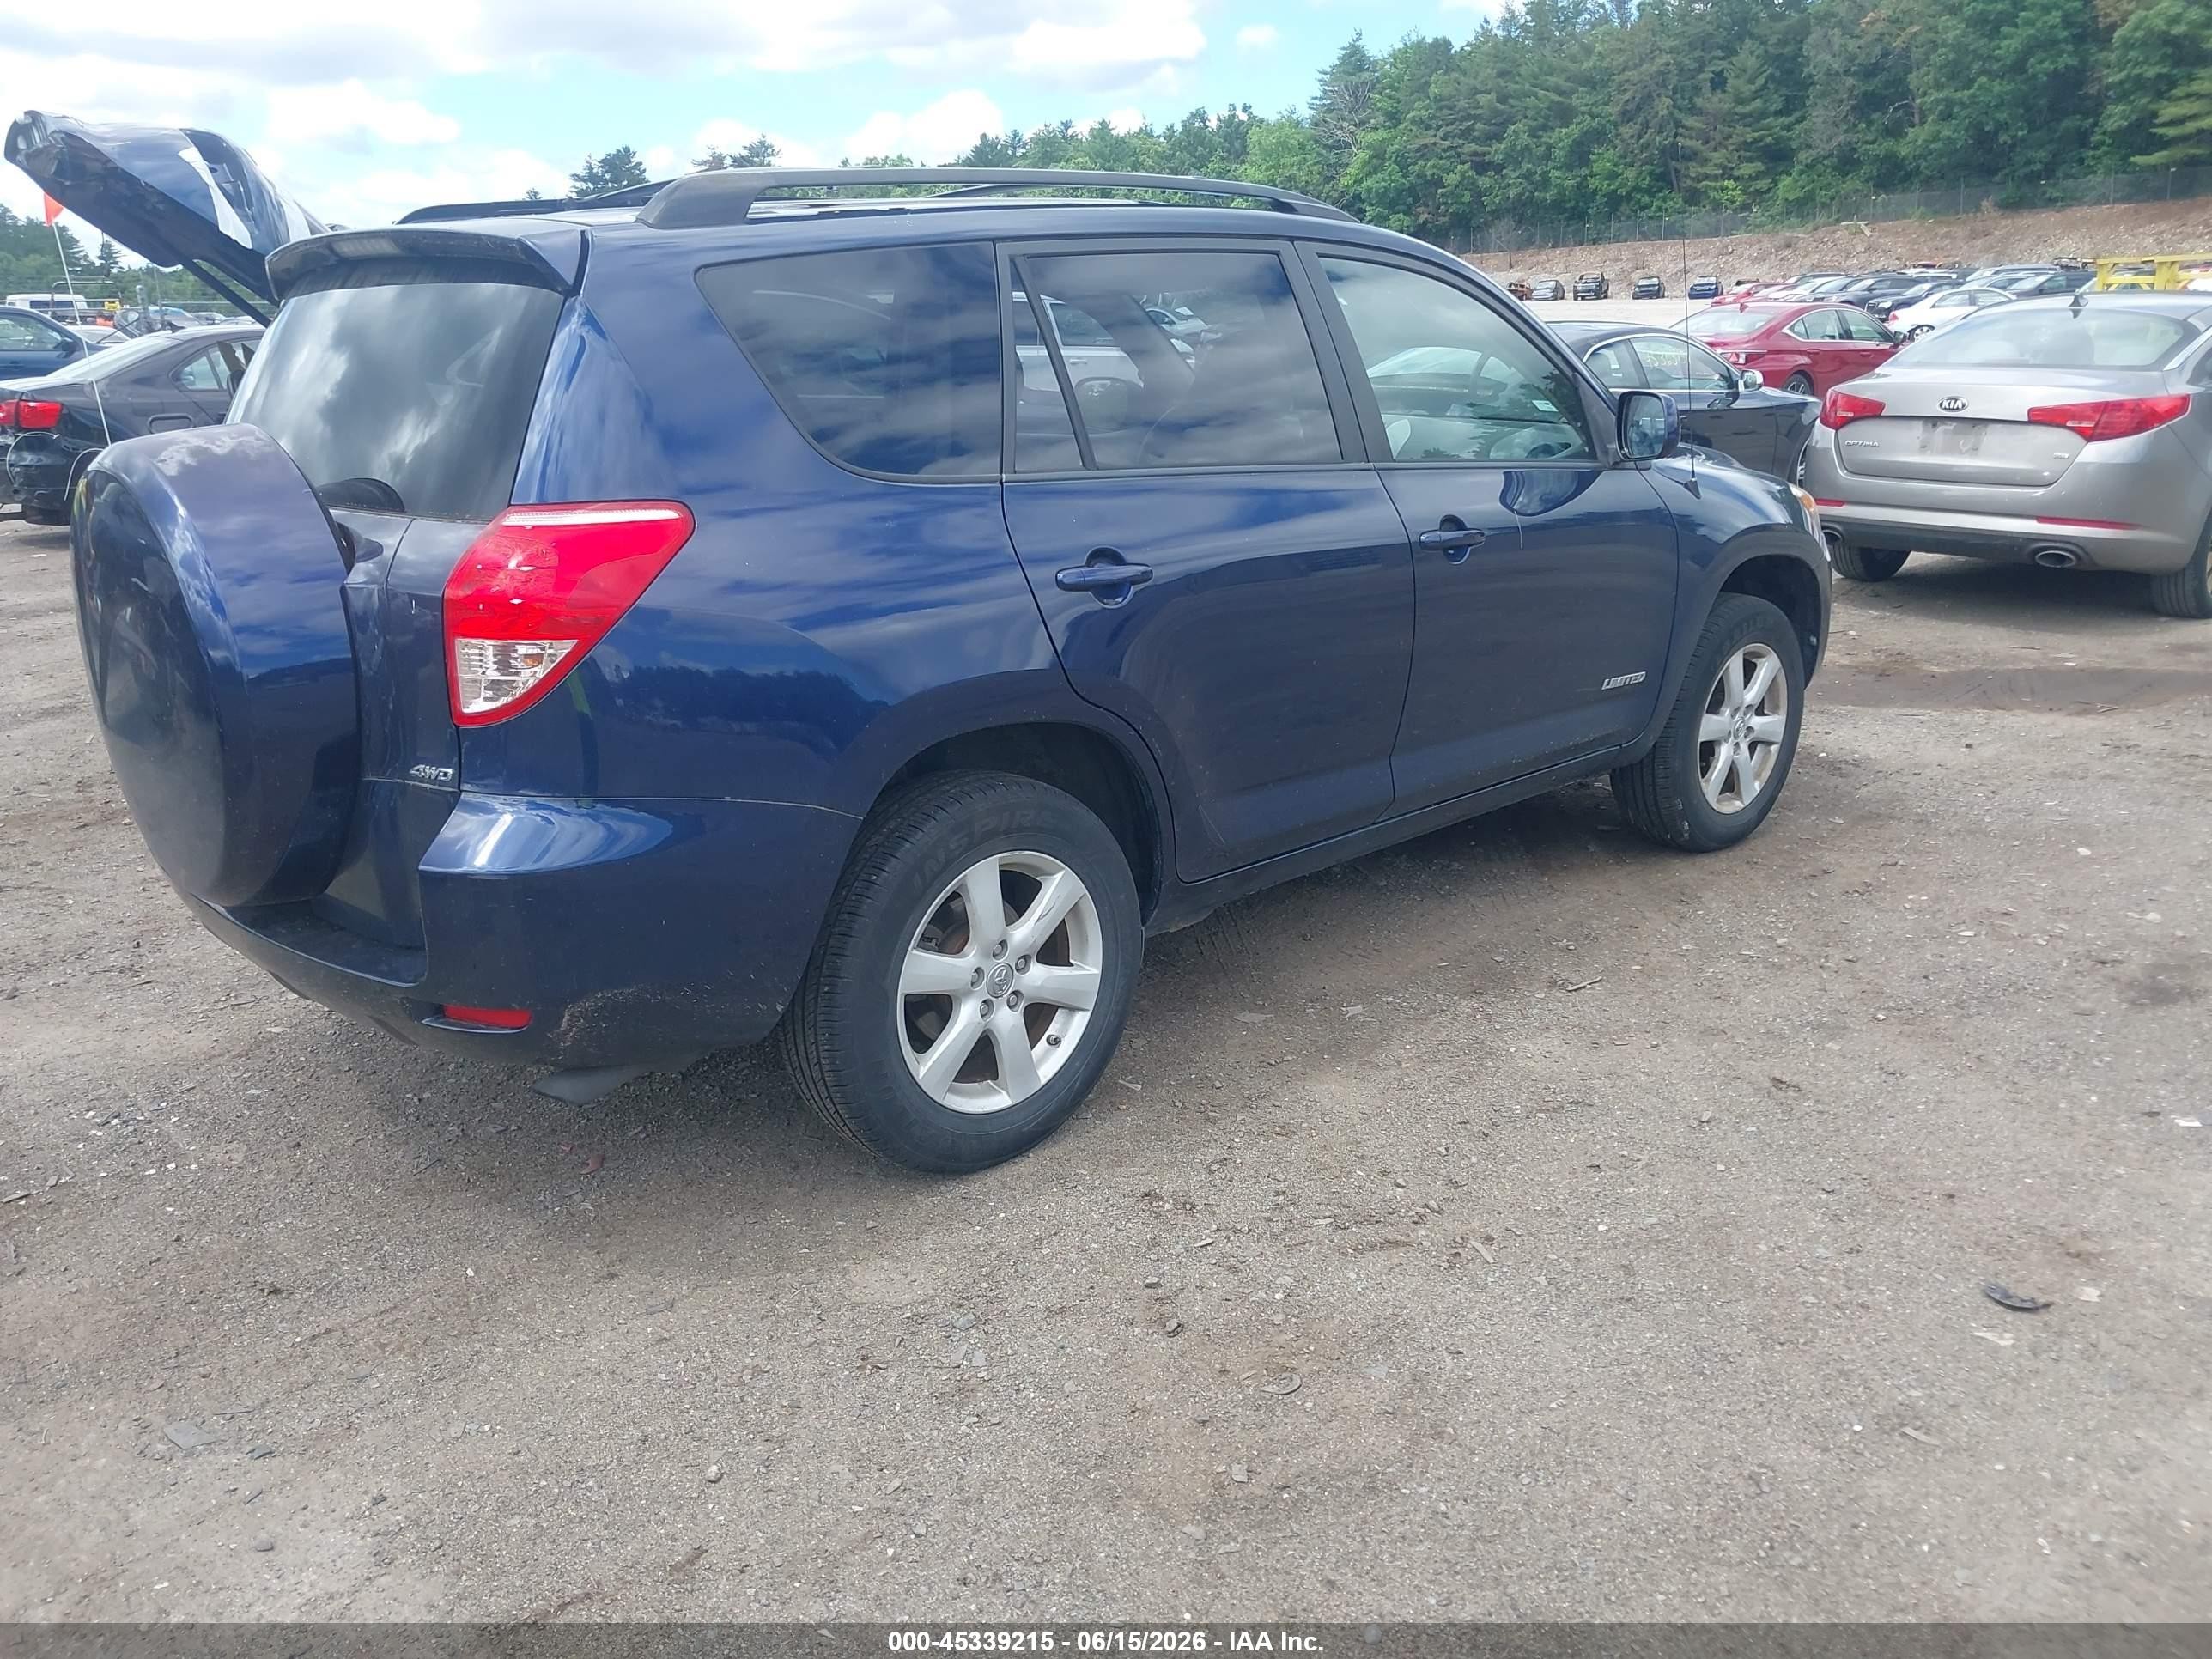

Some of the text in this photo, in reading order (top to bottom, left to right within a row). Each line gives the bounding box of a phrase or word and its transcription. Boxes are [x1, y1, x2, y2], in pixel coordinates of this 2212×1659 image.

[1942, 399, 1964, 410] KIA
[1601, 672, 1646, 690] LIMITED
[410, 764, 453, 781] 4WD
